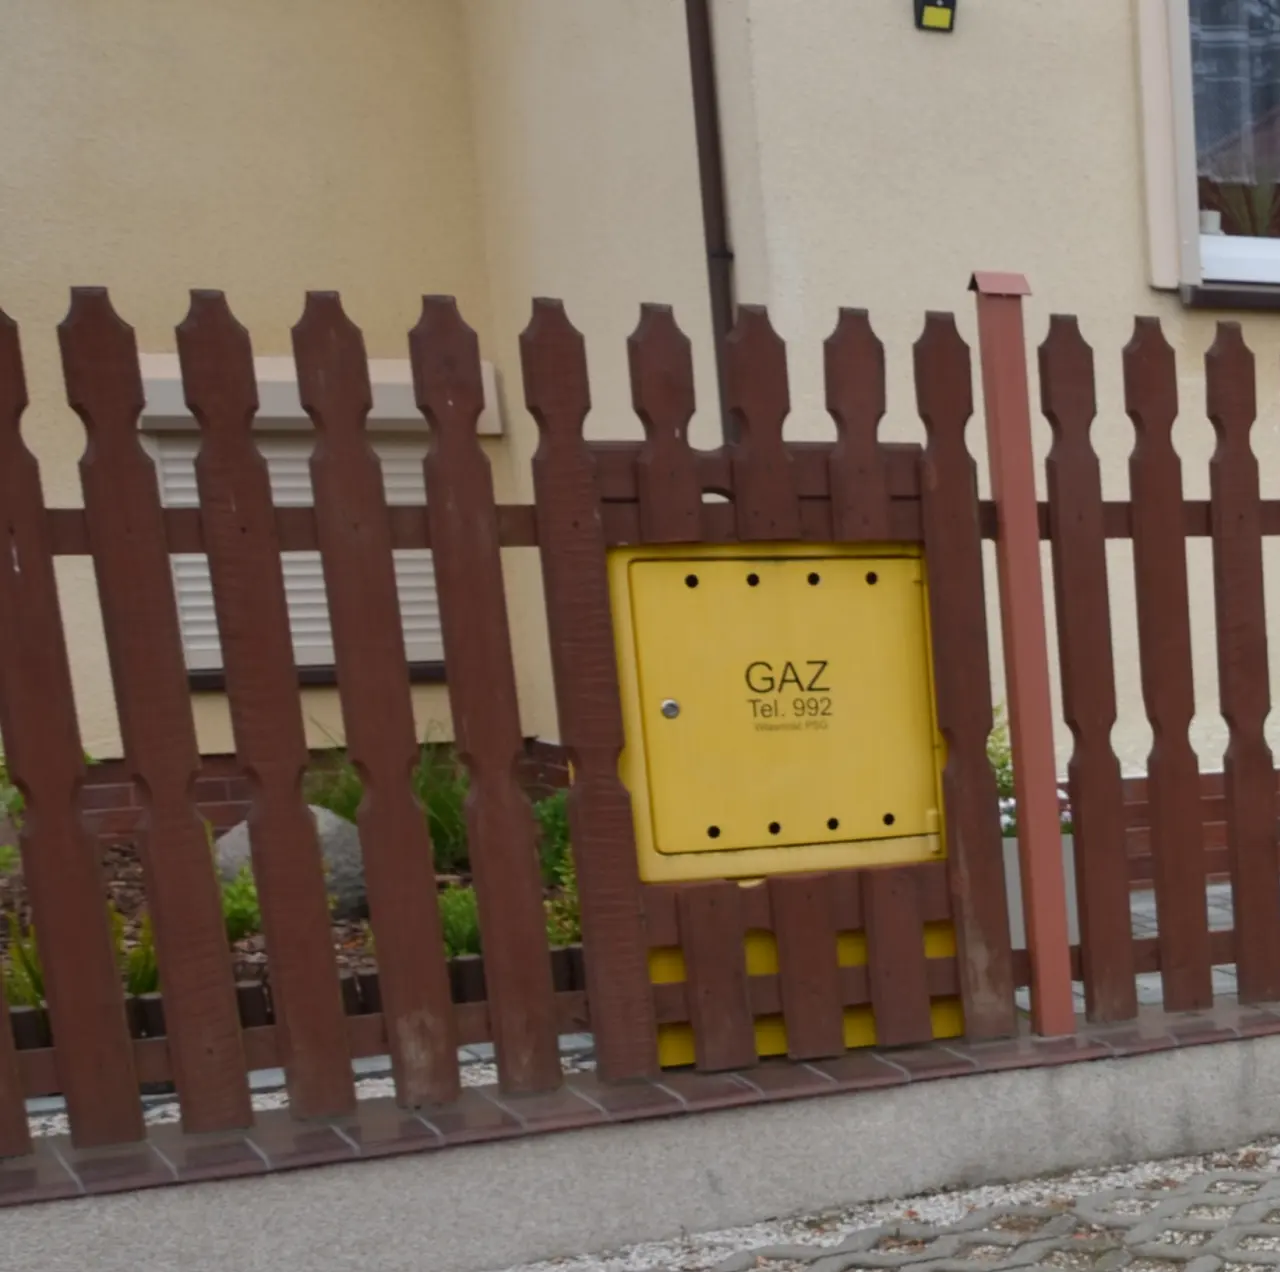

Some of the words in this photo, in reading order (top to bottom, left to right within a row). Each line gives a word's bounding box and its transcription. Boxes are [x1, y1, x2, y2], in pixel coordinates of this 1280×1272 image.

[745, 660, 830, 693] GAZ
[748, 699, 785, 718] Tel.
[793, 697, 832, 717] 992
